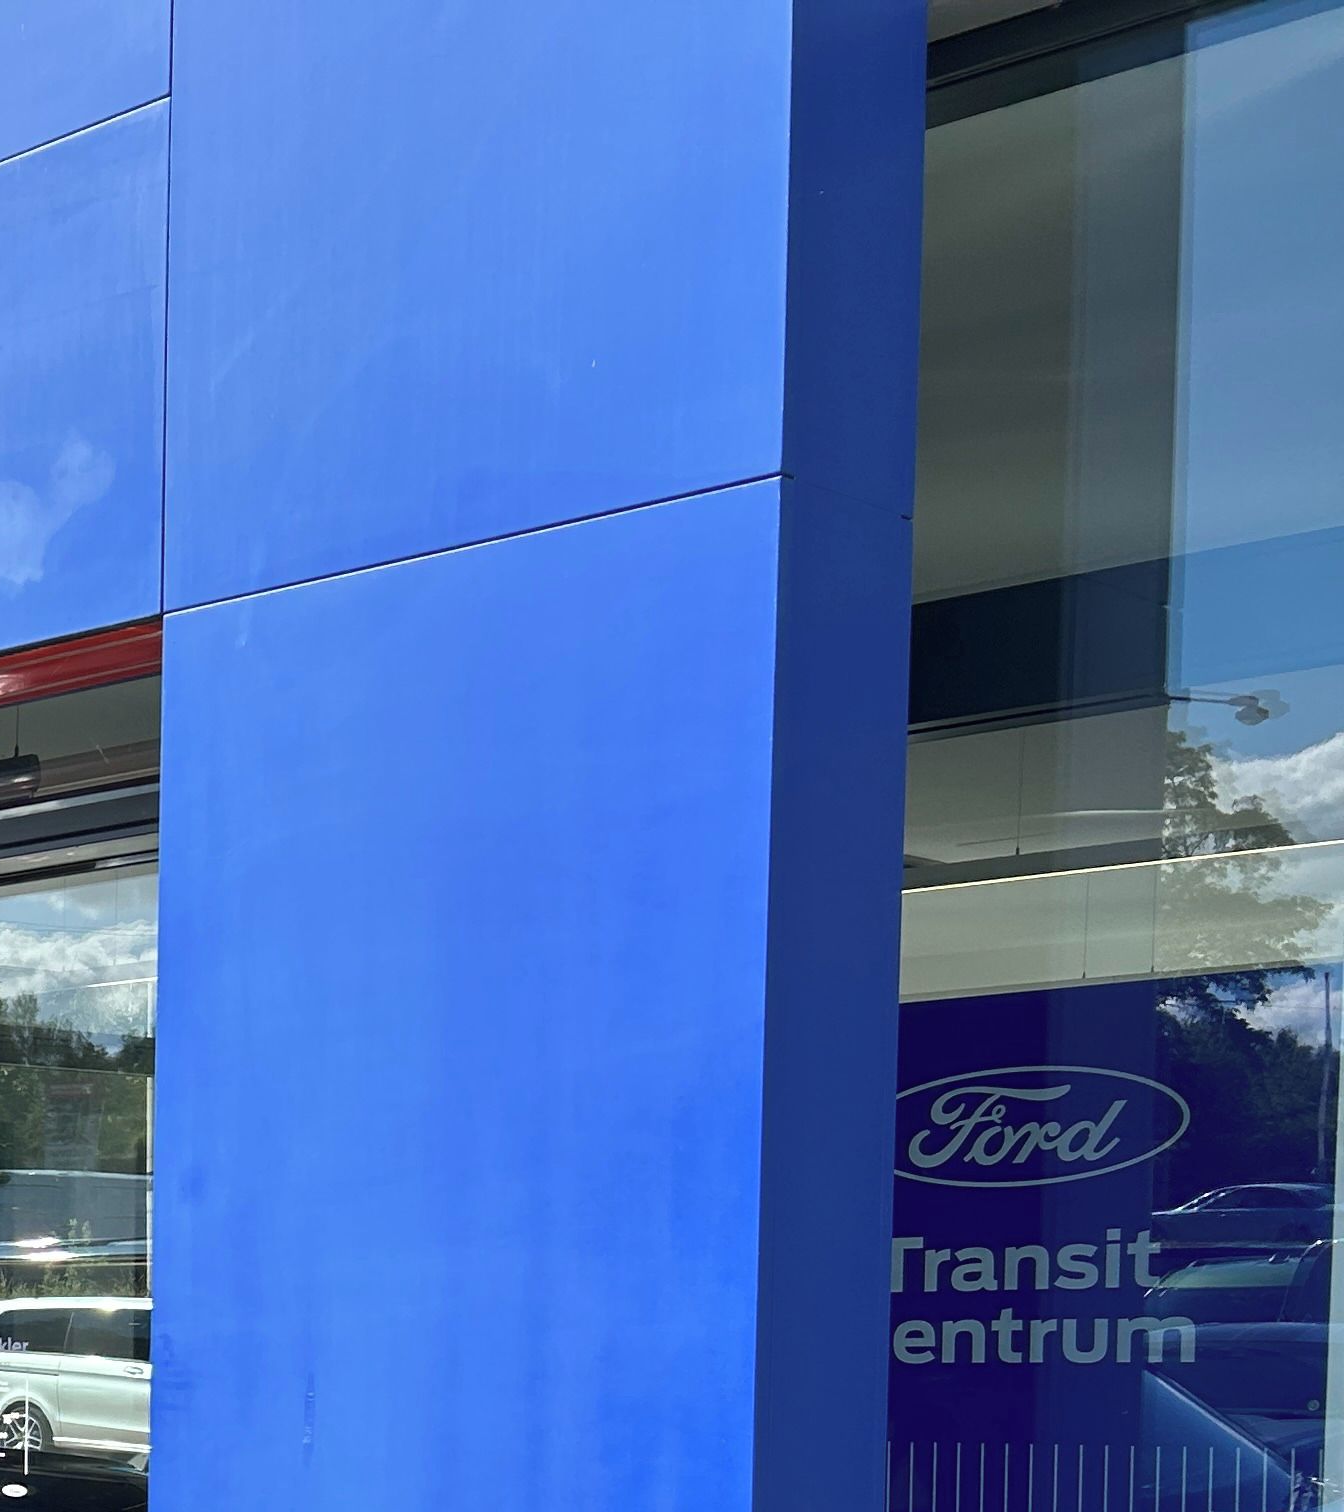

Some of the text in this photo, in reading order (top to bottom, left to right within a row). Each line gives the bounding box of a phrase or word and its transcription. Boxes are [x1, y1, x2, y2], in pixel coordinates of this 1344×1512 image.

[908, 1083, 1129, 1169] Ford
[890, 1227, 1162, 1293] Transit
[892, 1307, 1197, 1364] entrum
